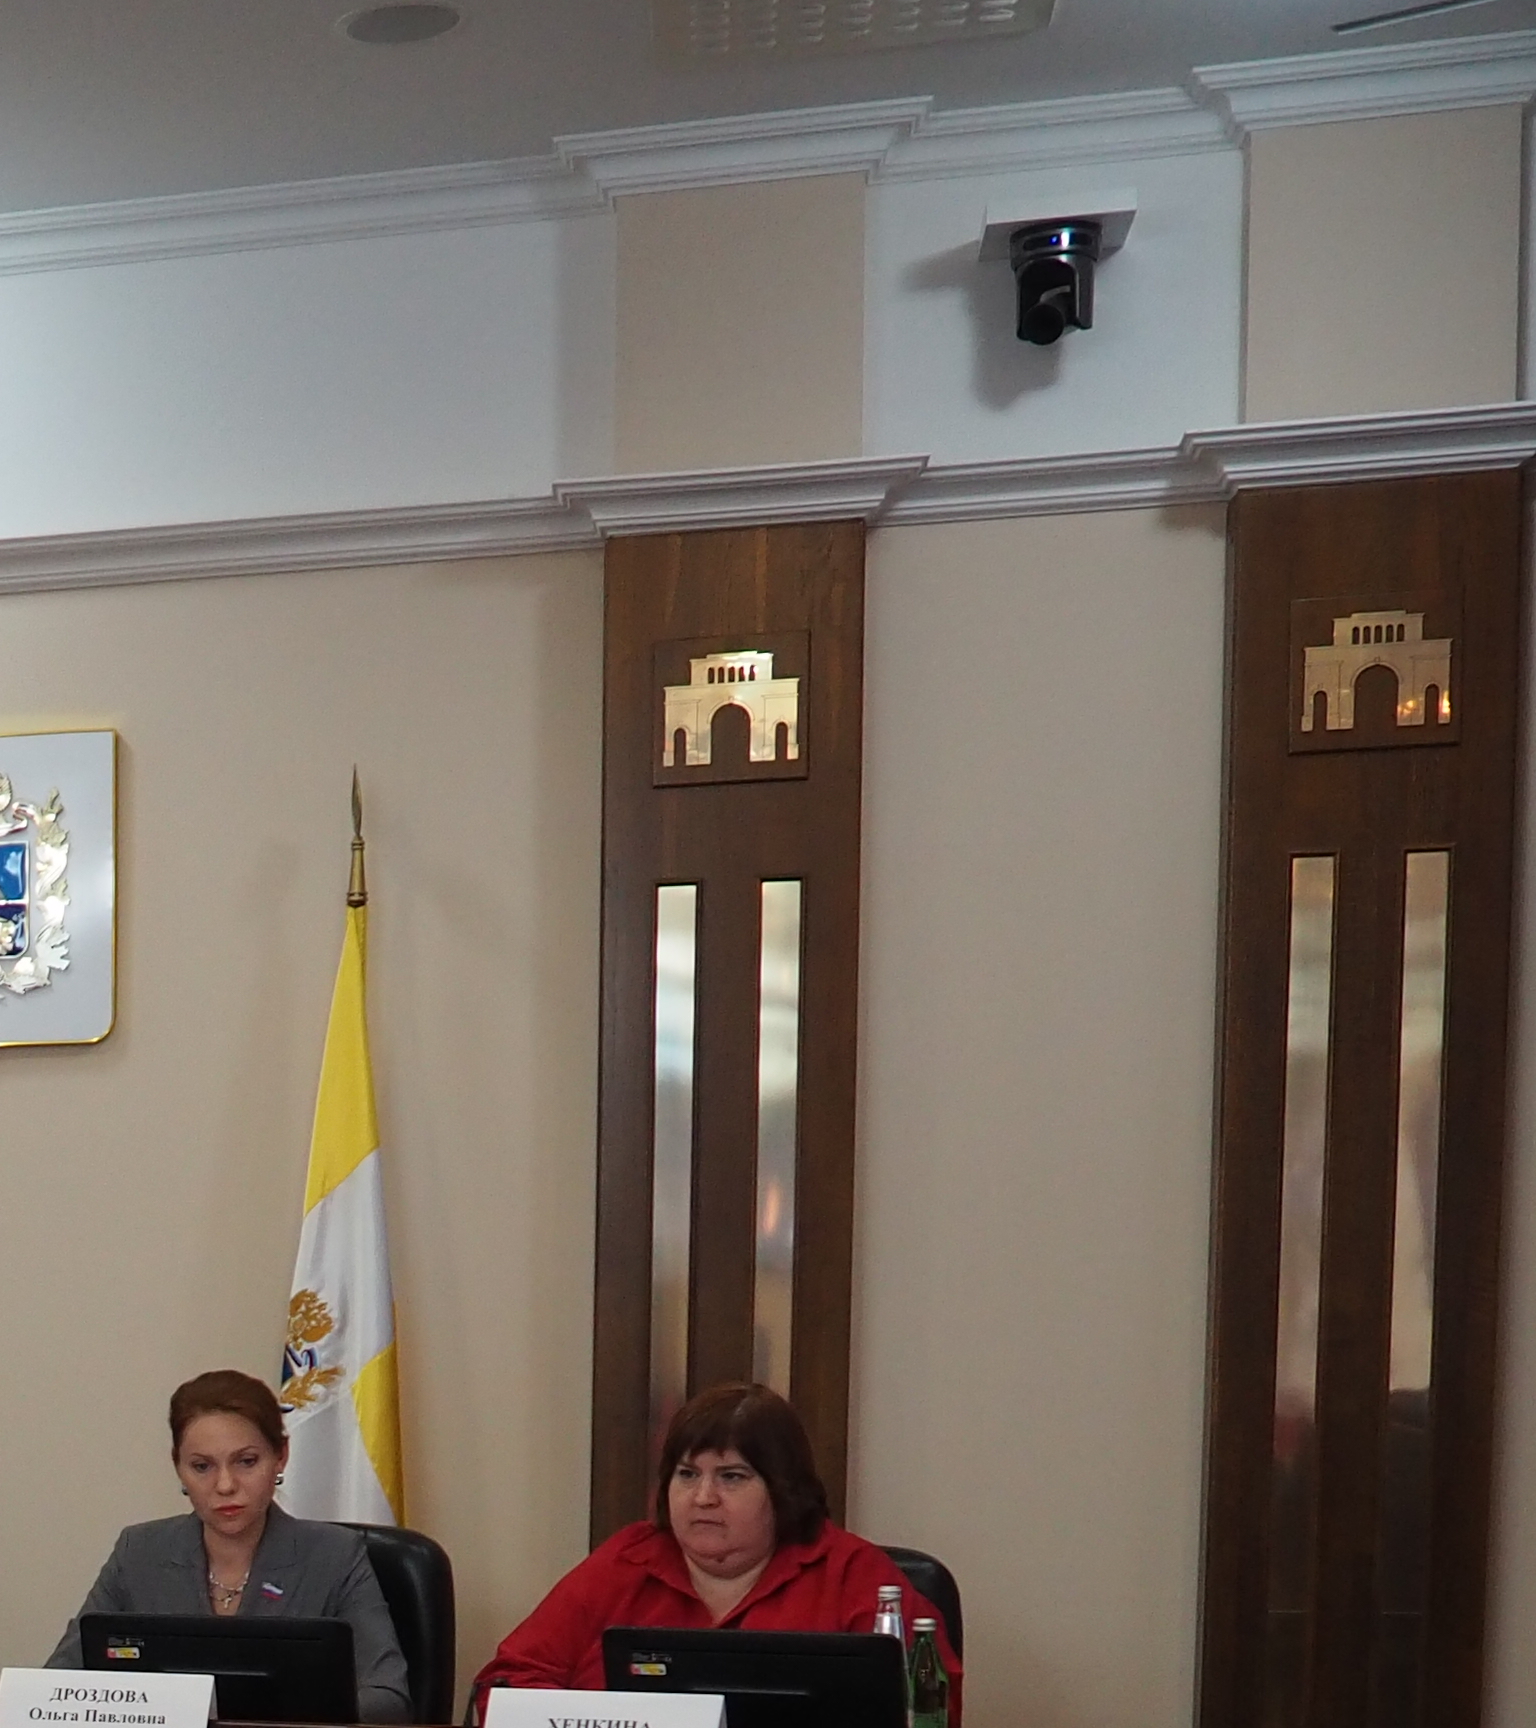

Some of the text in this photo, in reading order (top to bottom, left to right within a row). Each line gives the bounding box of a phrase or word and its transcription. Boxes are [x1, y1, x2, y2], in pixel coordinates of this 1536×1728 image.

[49, 1687, 149, 1704] ДРОЗДОВА
[29, 1706, 167, 1725] Ольга Павловна
